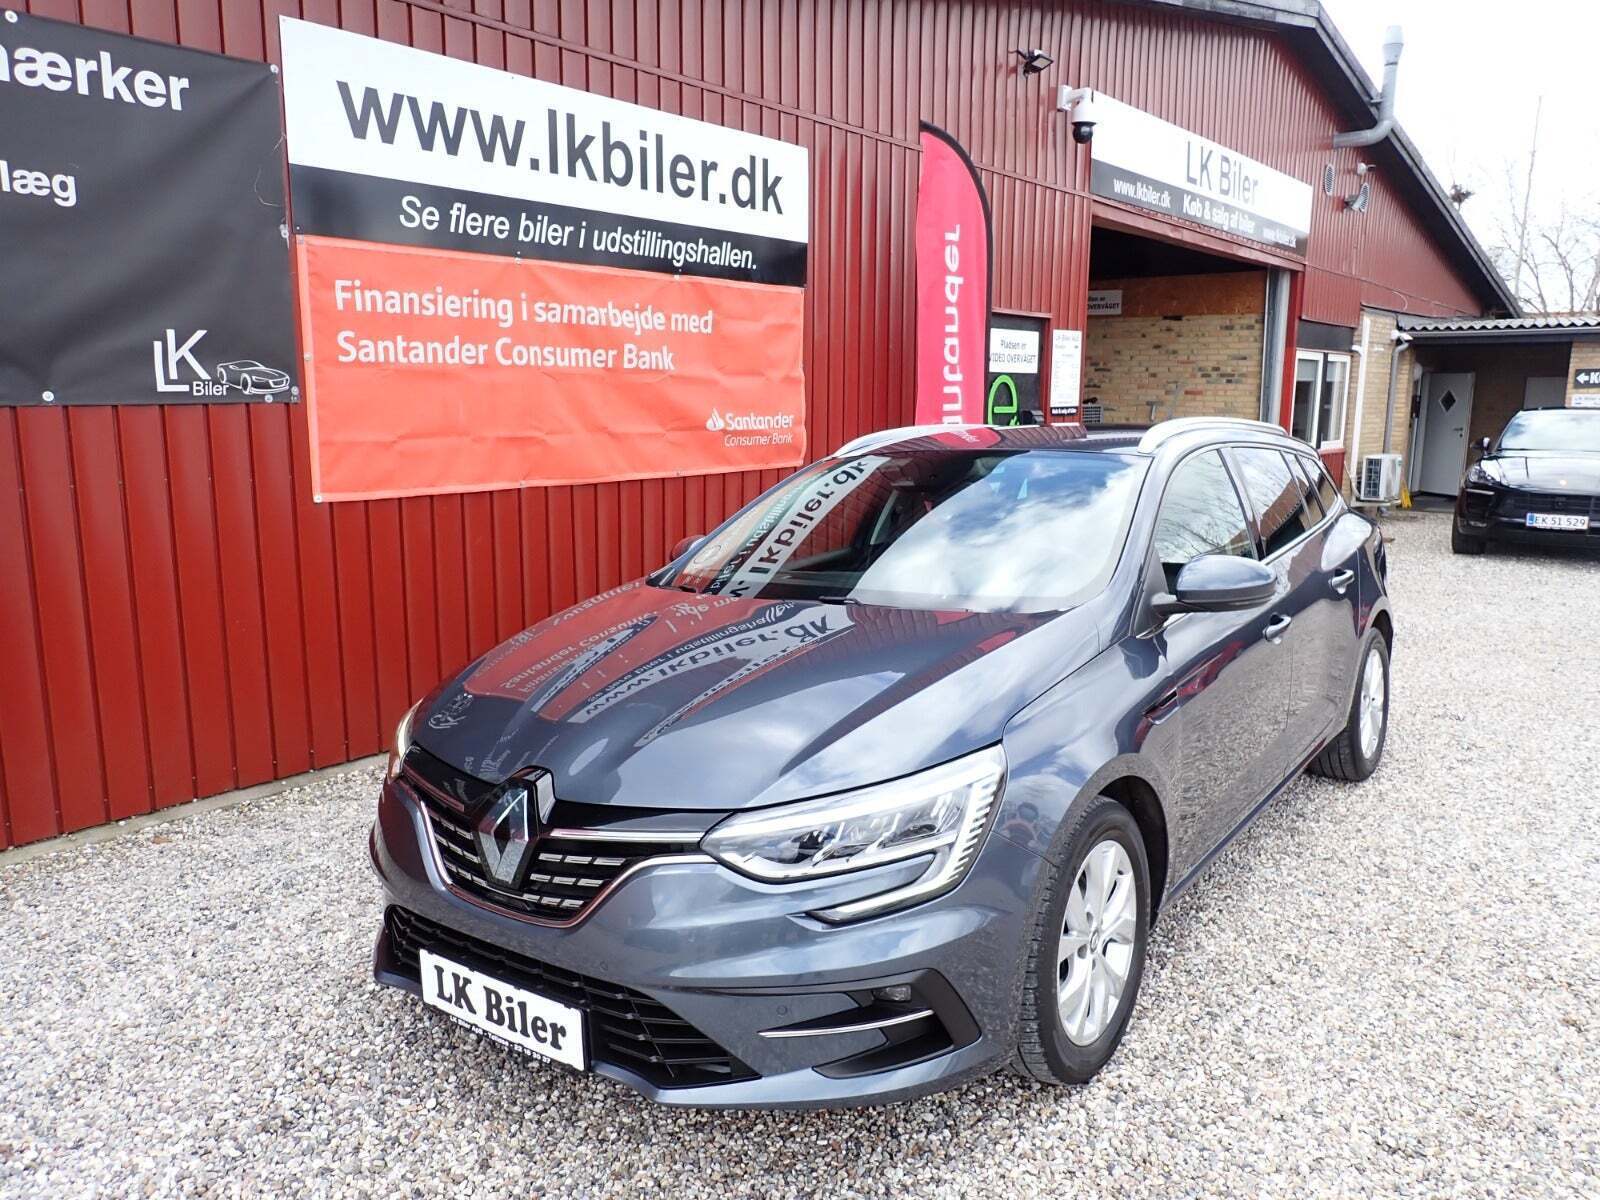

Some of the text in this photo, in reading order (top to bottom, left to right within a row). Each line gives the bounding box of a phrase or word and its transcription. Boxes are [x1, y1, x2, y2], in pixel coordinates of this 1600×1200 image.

[336, 80, 784, 215] www.lkbiler.dk
[1187, 141, 1258, 204] LK Biler
[1113, 178, 1171, 209] www.lkbiler.dk
[1204, 200, 1211, 220] &
[399, 195, 758, 271] Se flere biler i udstillingshallen.
[334, 279, 713, 336] Finansiering i samarbejde med
[153, 329, 229, 396] LK Biler
[336, 331, 674, 371] Santander Consumer Bank
[724, 432, 793, 447] Consumer Bank
[725, 411, 795, 431] Santander
[434, 964, 567, 1050] LK Biler
